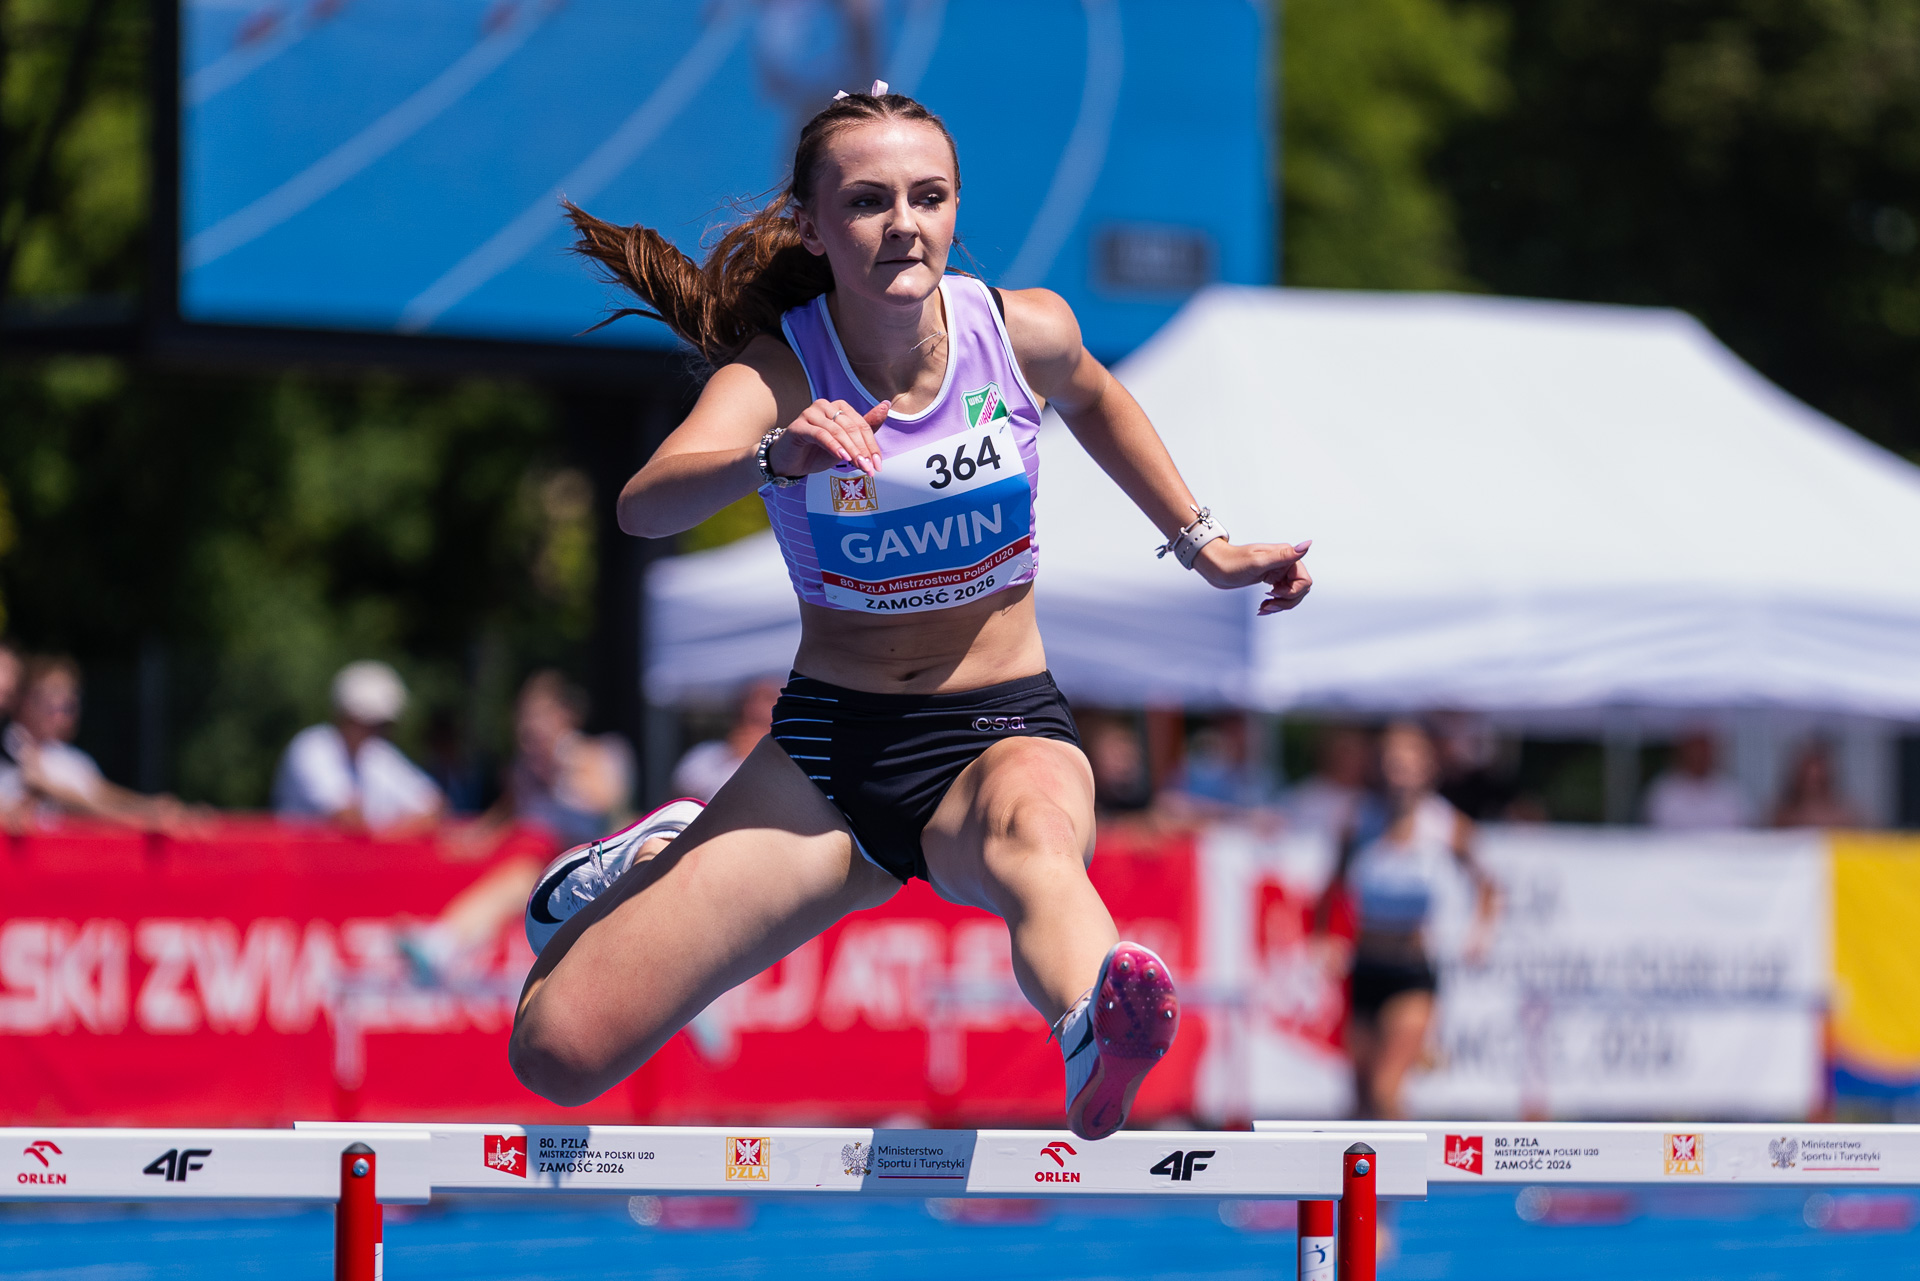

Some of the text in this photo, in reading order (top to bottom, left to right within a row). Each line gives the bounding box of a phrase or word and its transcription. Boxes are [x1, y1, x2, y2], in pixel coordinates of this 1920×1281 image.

[926, 435, 1001, 490] 364
[835, 499, 875, 511] PZLA
[840, 503, 1003, 564] GAWIN
[839, 547, 1014, 593] 80. PZLA Mistrzostwa Polski U20
[865, 574, 996, 610] ZAMOŚĆ 2026
[539, 1138, 589, 1149] 80. PZLA
[1494, 1137, 1539, 1147] 80. PZLA
[1801, 1140, 1861, 1149] Ministerstwo
[539, 1150, 655, 1160] MISTRZOSTWA POLSKI U20
[878, 1145, 944, 1156] Ministerstwo
[1494, 1148, 1600, 1157] MISTRZOSTWA POLSKI U20
[1801, 1151, 1832, 1162] Sportu
[1840, 1151, 1881, 1162] Turystyki
[142, 1148, 213, 1182] 4F
[539, 1160, 625, 1174] ZAMOŚĆ 2026
[877, 1158, 912, 1170] Sportu
[919, 1158, 966, 1170] Turystyki
[1149, 1150, 1216, 1181] 4F
[1494, 1159, 1571, 1170] ZAMOŚĆ 2026
[1666, 1161, 1701, 1173] PZLA
[17, 1173, 67, 1185] ORLEN
[728, 1167, 767, 1179] PZLA
[1034, 1171, 1080, 1183] ORLEN
